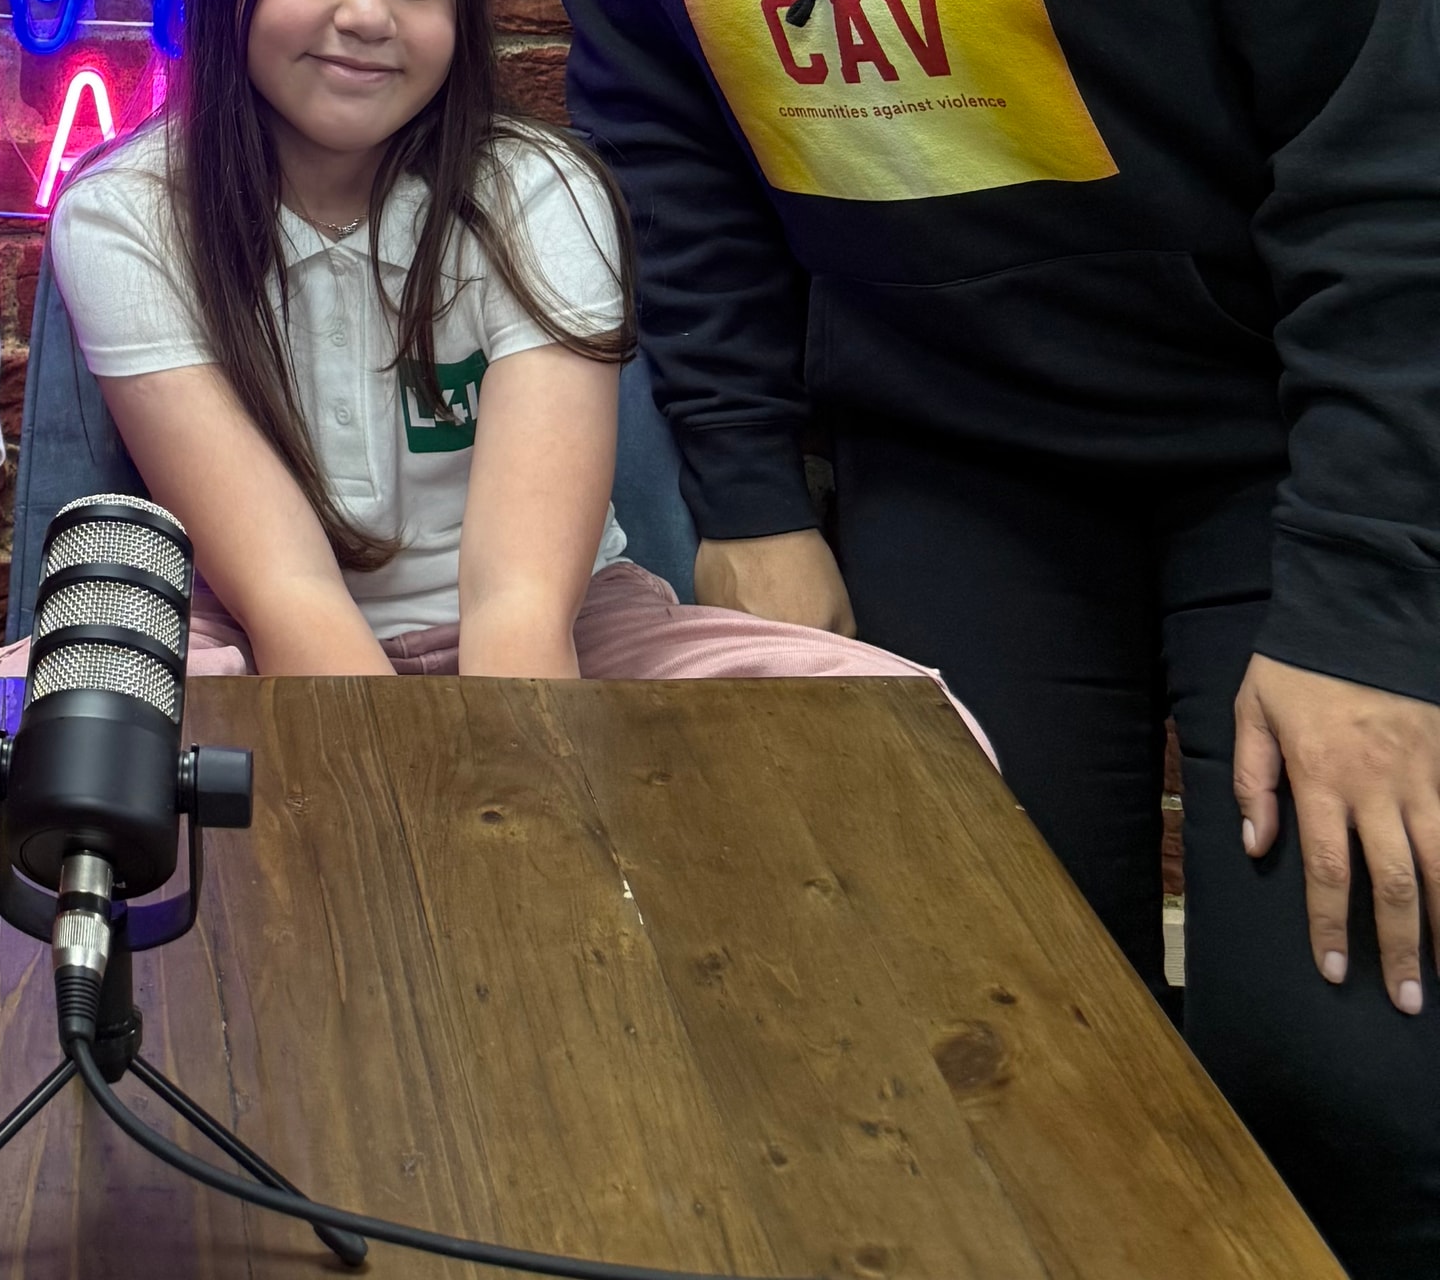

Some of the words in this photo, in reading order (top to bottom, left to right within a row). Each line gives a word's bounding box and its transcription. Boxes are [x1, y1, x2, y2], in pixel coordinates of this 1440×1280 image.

[779, 104, 868, 119] communities
[873, 100, 934, 120] against
[936, 93, 1008, 110] violence
